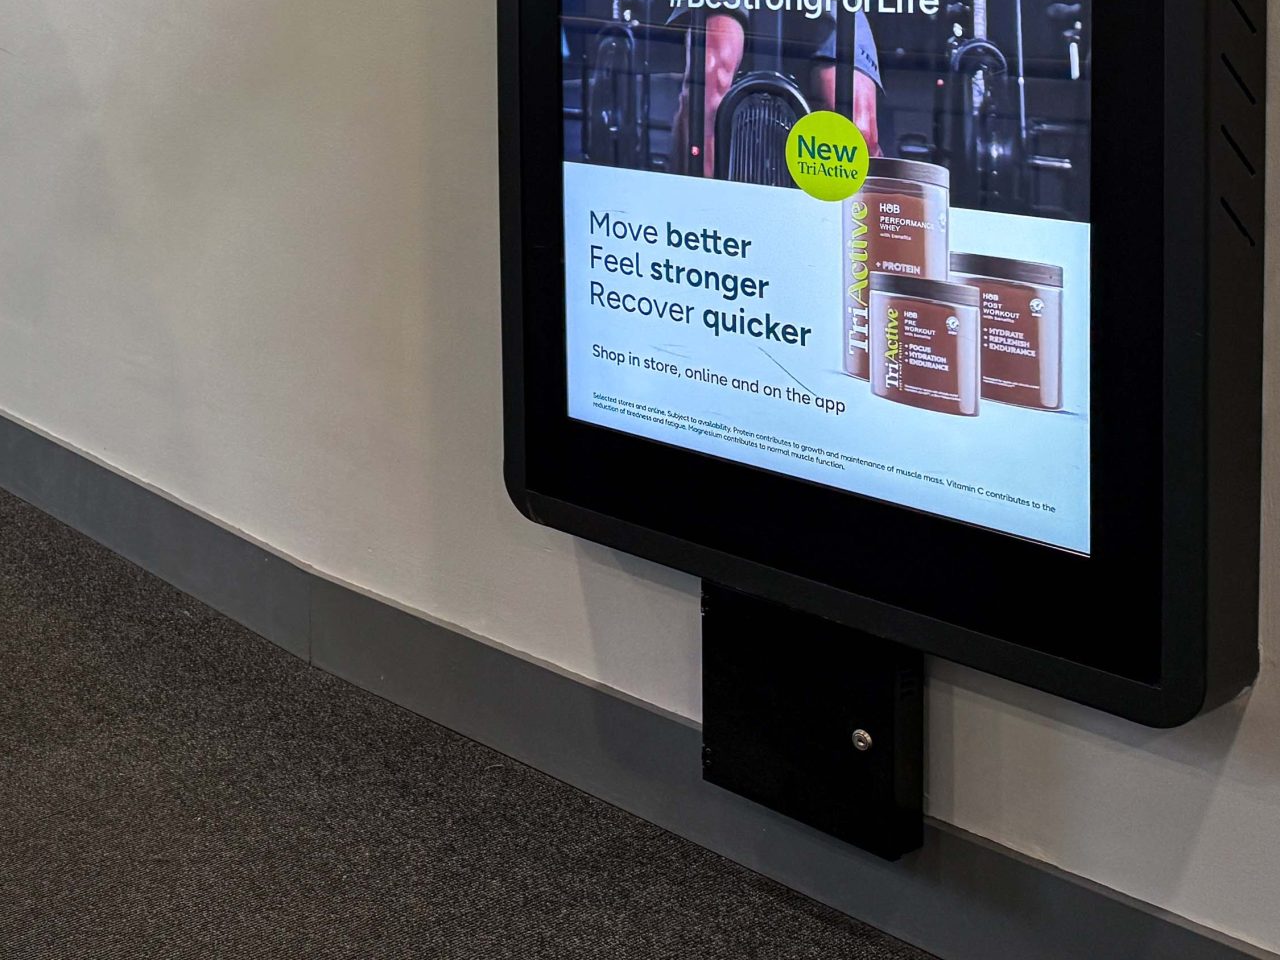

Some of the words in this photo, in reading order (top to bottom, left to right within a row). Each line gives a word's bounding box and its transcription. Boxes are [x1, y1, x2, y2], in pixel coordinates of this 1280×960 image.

[797, 134, 858, 163] New
[798, 161, 859, 180] TriActive
[590, 210, 659, 244] Move
[666, 221, 752, 259] better
[879, 223, 901, 232] WHEY
[590, 244, 643, 278] Feel
[650, 258, 770, 301] stronger
[882, 260, 921, 274] PROTEIN
[983, 301, 1003, 309] POST
[590, 280, 695, 324] Recover
[703, 307, 812, 347] quicker
[983, 308, 1020, 319] WORKOUT
[904, 325, 936, 336] WORKOUT
[989, 327, 1025, 339] HYDRATE
[909, 343, 932, 353] FOCUS
[989, 335, 1030, 348] REPLENISH
[909, 351, 947, 363] HYDRATION
[989, 343, 1037, 357] ENDURANCE
[909, 359, 949, 372] ENDURANCE
[592, 344, 626, 365] Shop
[628, 351, 641, 367] in
[643, 357, 682, 378] store,
[685, 365, 728, 387] online
[731, 377, 760, 394] and
[763, 385, 782, 399] on
[786, 387, 817, 405] the
[814, 395, 846, 416] app
[592, 401, 620, 414] reduction
[619, 407, 627, 415] of
[652, 416, 664, 425] and
[688, 424, 723, 439] Magnesium
[723, 432, 758, 448] contributes
[766, 444, 790, 457] normal
[791, 450, 815, 462] muscle
[815, 455, 846, 471] function.
[593, 391, 618, 405] Selected
[618, 398, 635, 408] stores
[635, 403, 647, 411] and
[667, 410, 690, 423] Subject
[690, 416, 697, 424] to
[733, 426, 755, 438] Protein
[756, 431, 792, 447] contributes
[793, 441, 800, 449] to
[801, 443, 825, 457] growth
[825, 449, 839, 459] and
[840, 453, 886, 471] maintenance
[887, 465, 895, 473] of
[895, 467, 922, 481] muscle
[923, 474, 945, 486] mass.
[946, 478, 976, 493] Vitamin
[977, 487, 984, 495] C
[985, 490, 1031, 506] contributes
[1032, 500, 1041, 509] to
[1042, 502, 1056, 513] the
